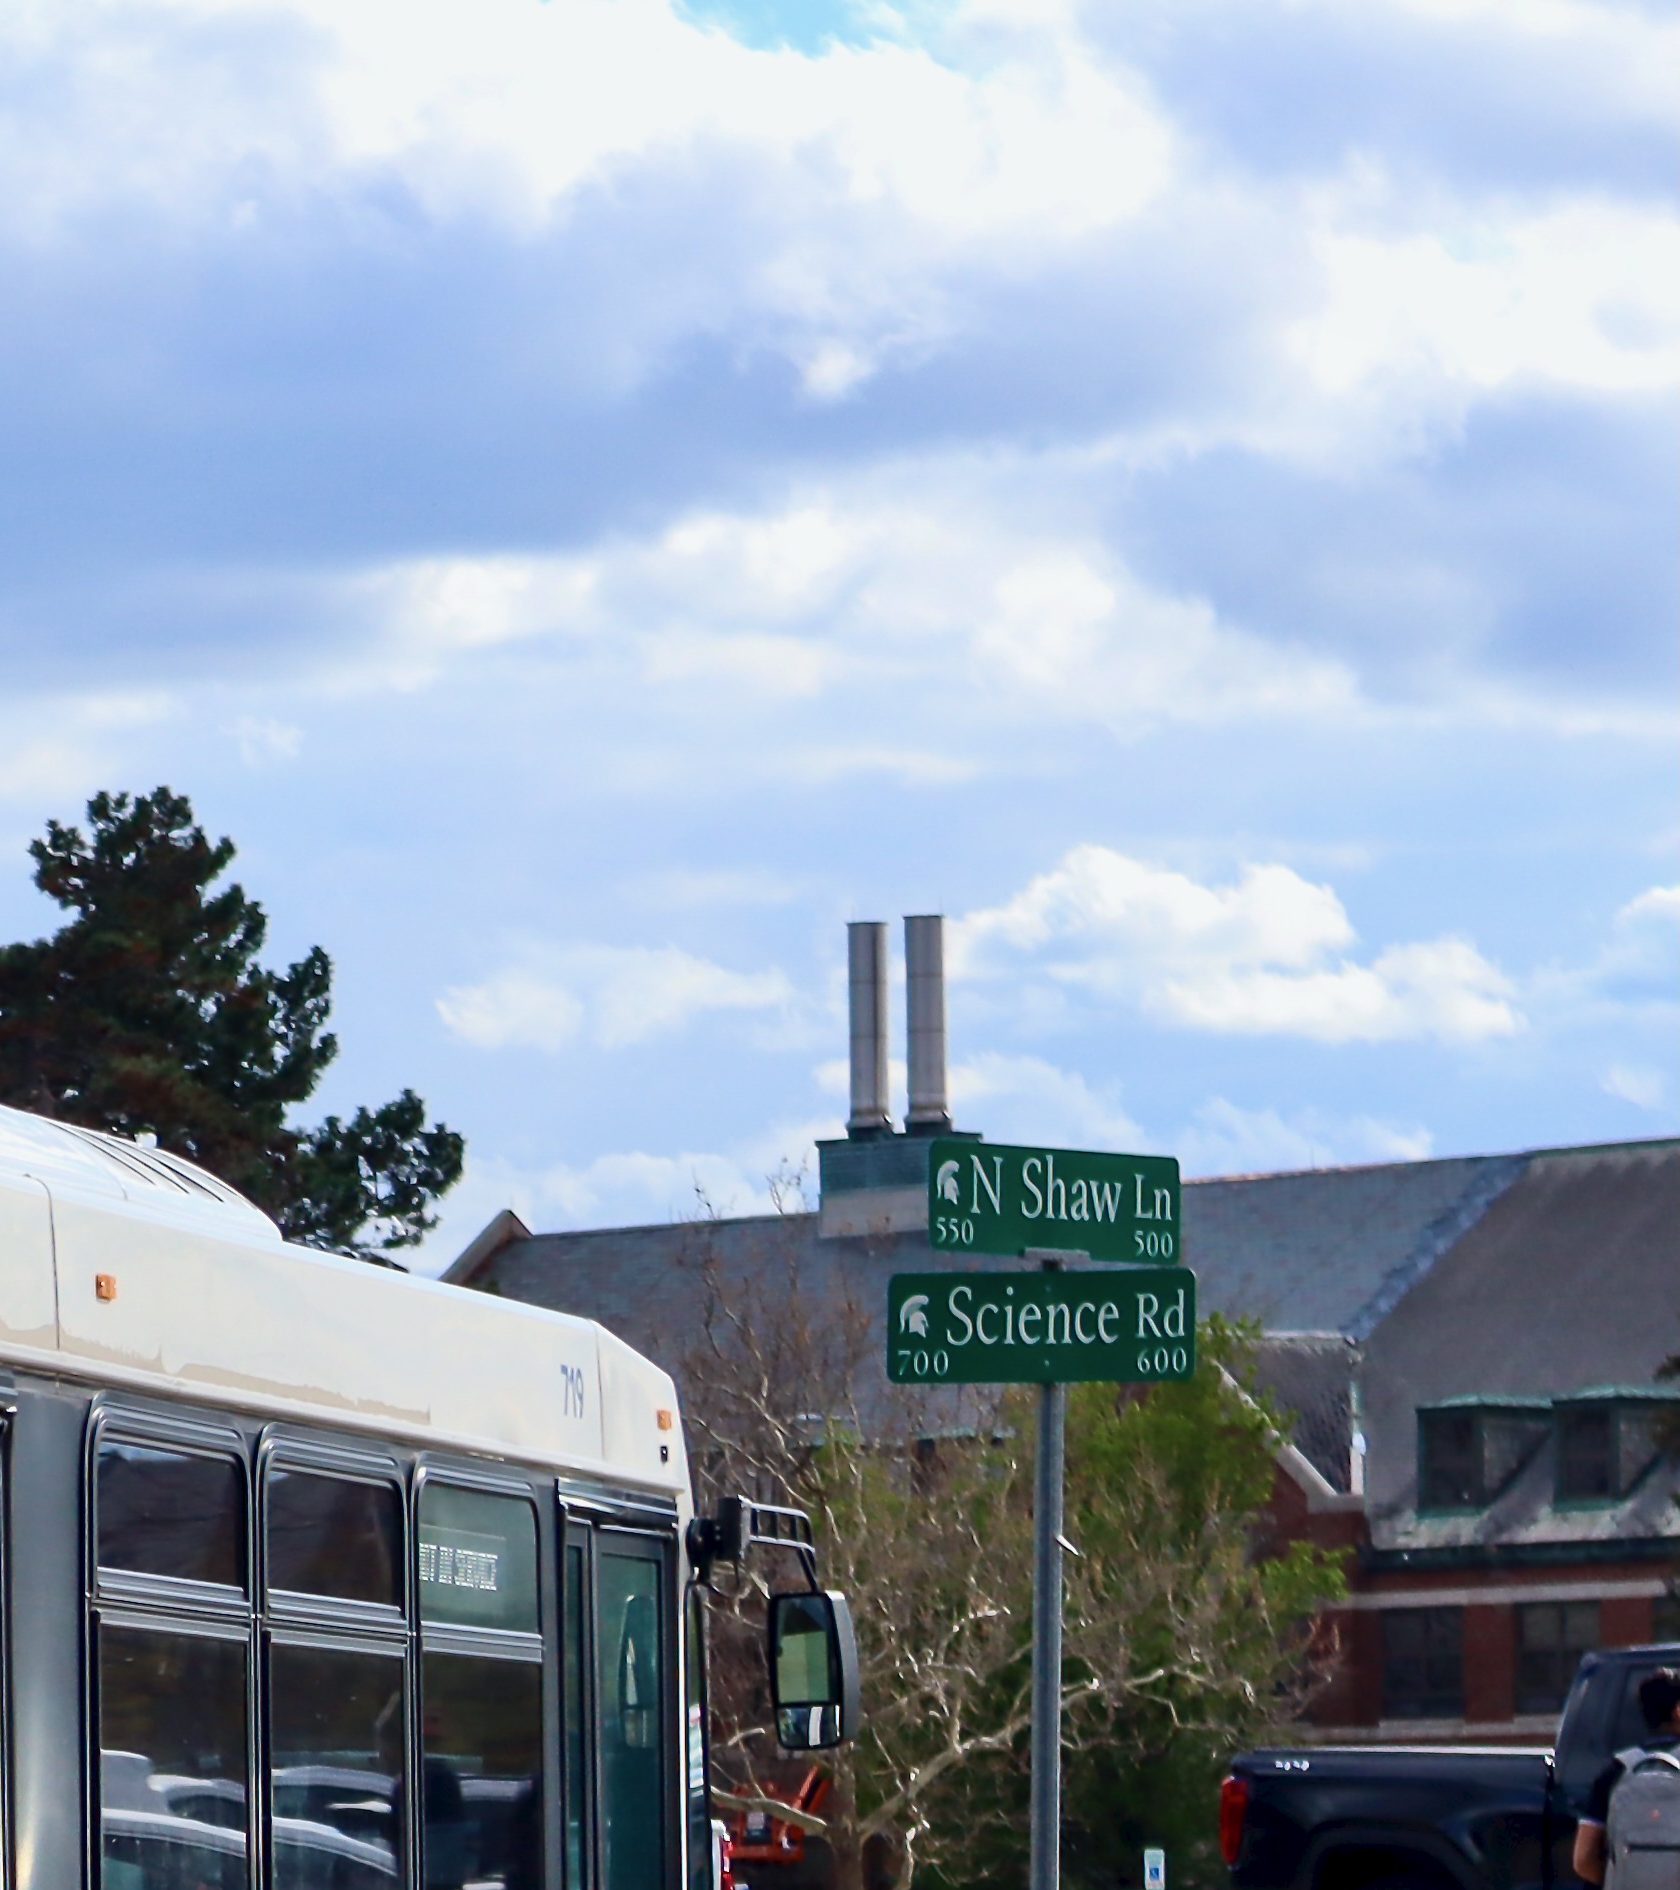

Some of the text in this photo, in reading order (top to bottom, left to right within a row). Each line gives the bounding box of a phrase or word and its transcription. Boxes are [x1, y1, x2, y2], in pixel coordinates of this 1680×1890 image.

[970, 1154, 1172, 1223] N Shaw Ln
[936, 1216, 1173, 1258] 550 500
[946, 1286, 1185, 1346] Science Rd
[898, 1346, 1187, 1376] 700 600
[560, 1364, 584, 1419] 719
